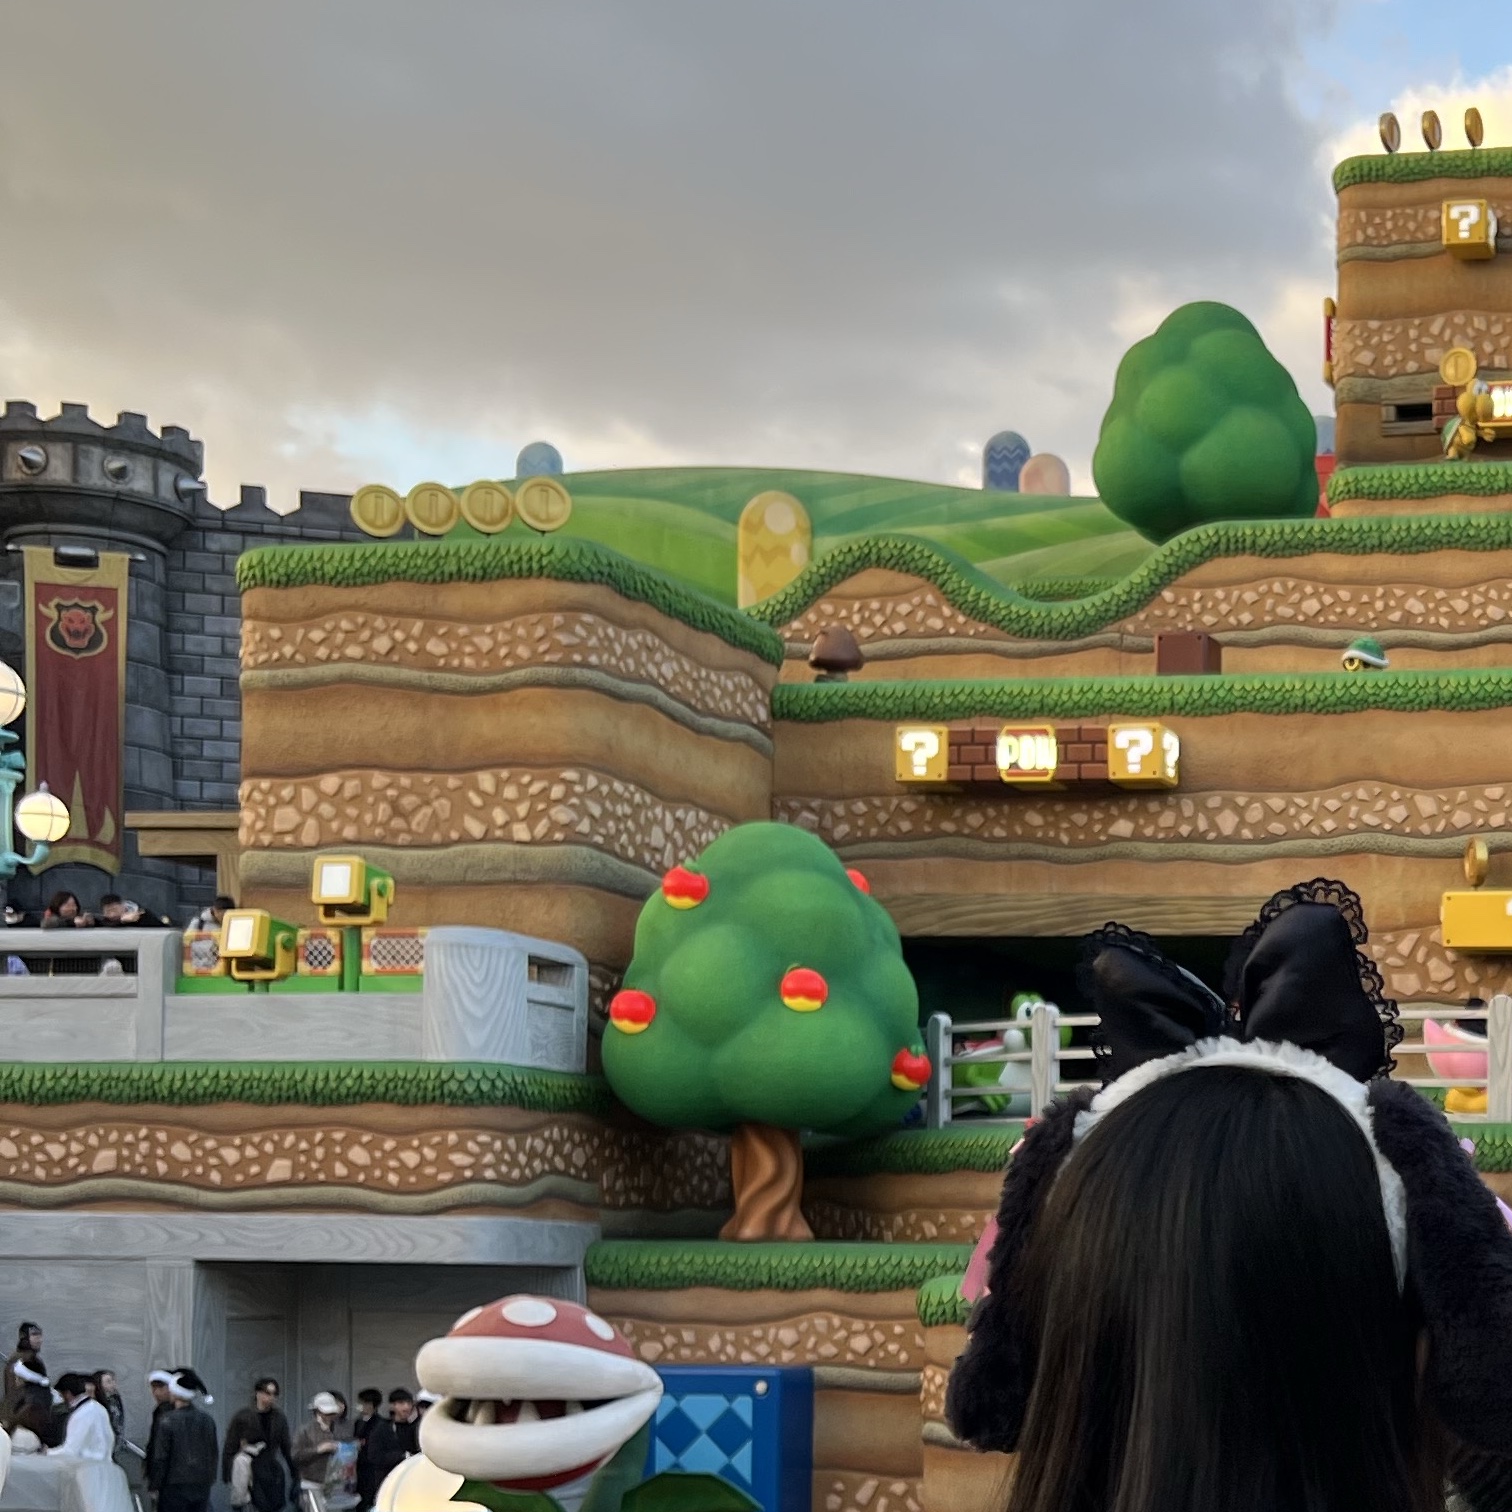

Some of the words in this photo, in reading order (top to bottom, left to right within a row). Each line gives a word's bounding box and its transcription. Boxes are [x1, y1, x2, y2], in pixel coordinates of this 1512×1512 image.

[1449, 205, 1480, 239] ?
[901, 731, 940, 777] ?
[996, 734, 1058, 770] POW
[1115, 730, 1154, 774] ?
